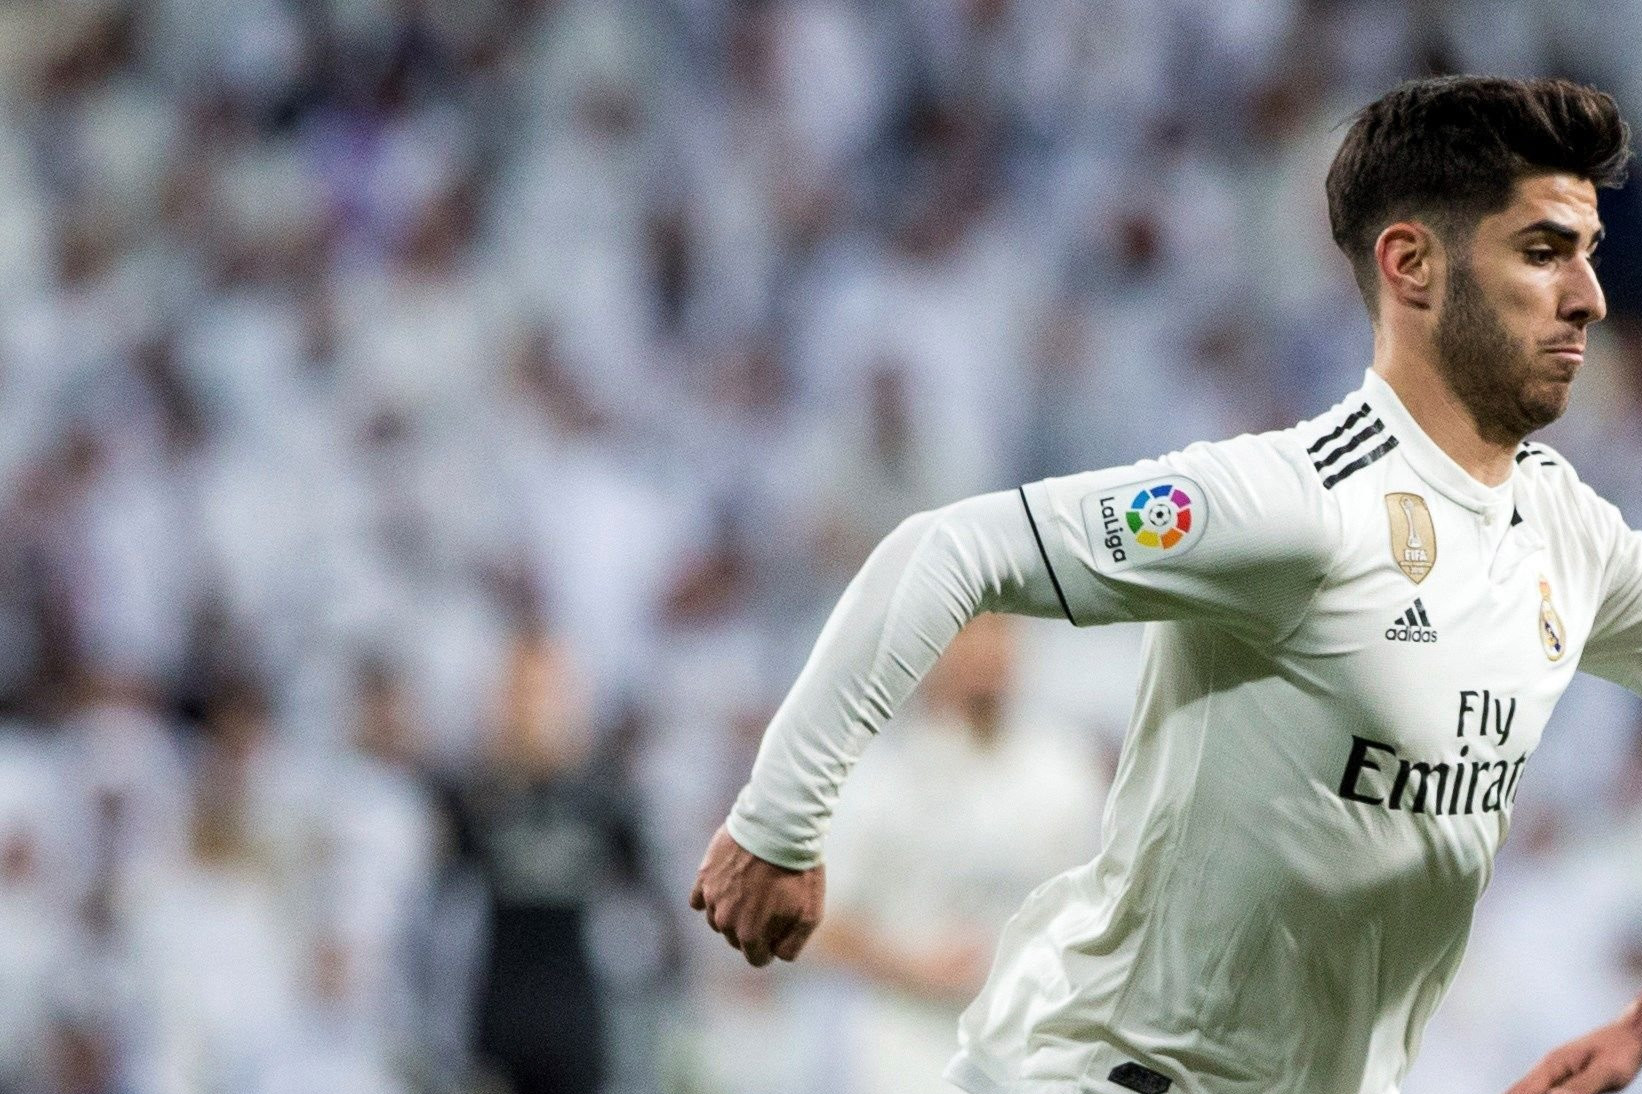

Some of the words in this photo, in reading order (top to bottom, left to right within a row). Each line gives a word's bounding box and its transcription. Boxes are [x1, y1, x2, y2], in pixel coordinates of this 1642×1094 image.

[1100, 496, 1127, 563] LaLiga
[1404, 548, 1428, 562] FIFA
[1385, 625, 1438, 643] adidas
[1457, 690, 1516, 746] Fly
[1338, 734, 1526, 816] Emirat
